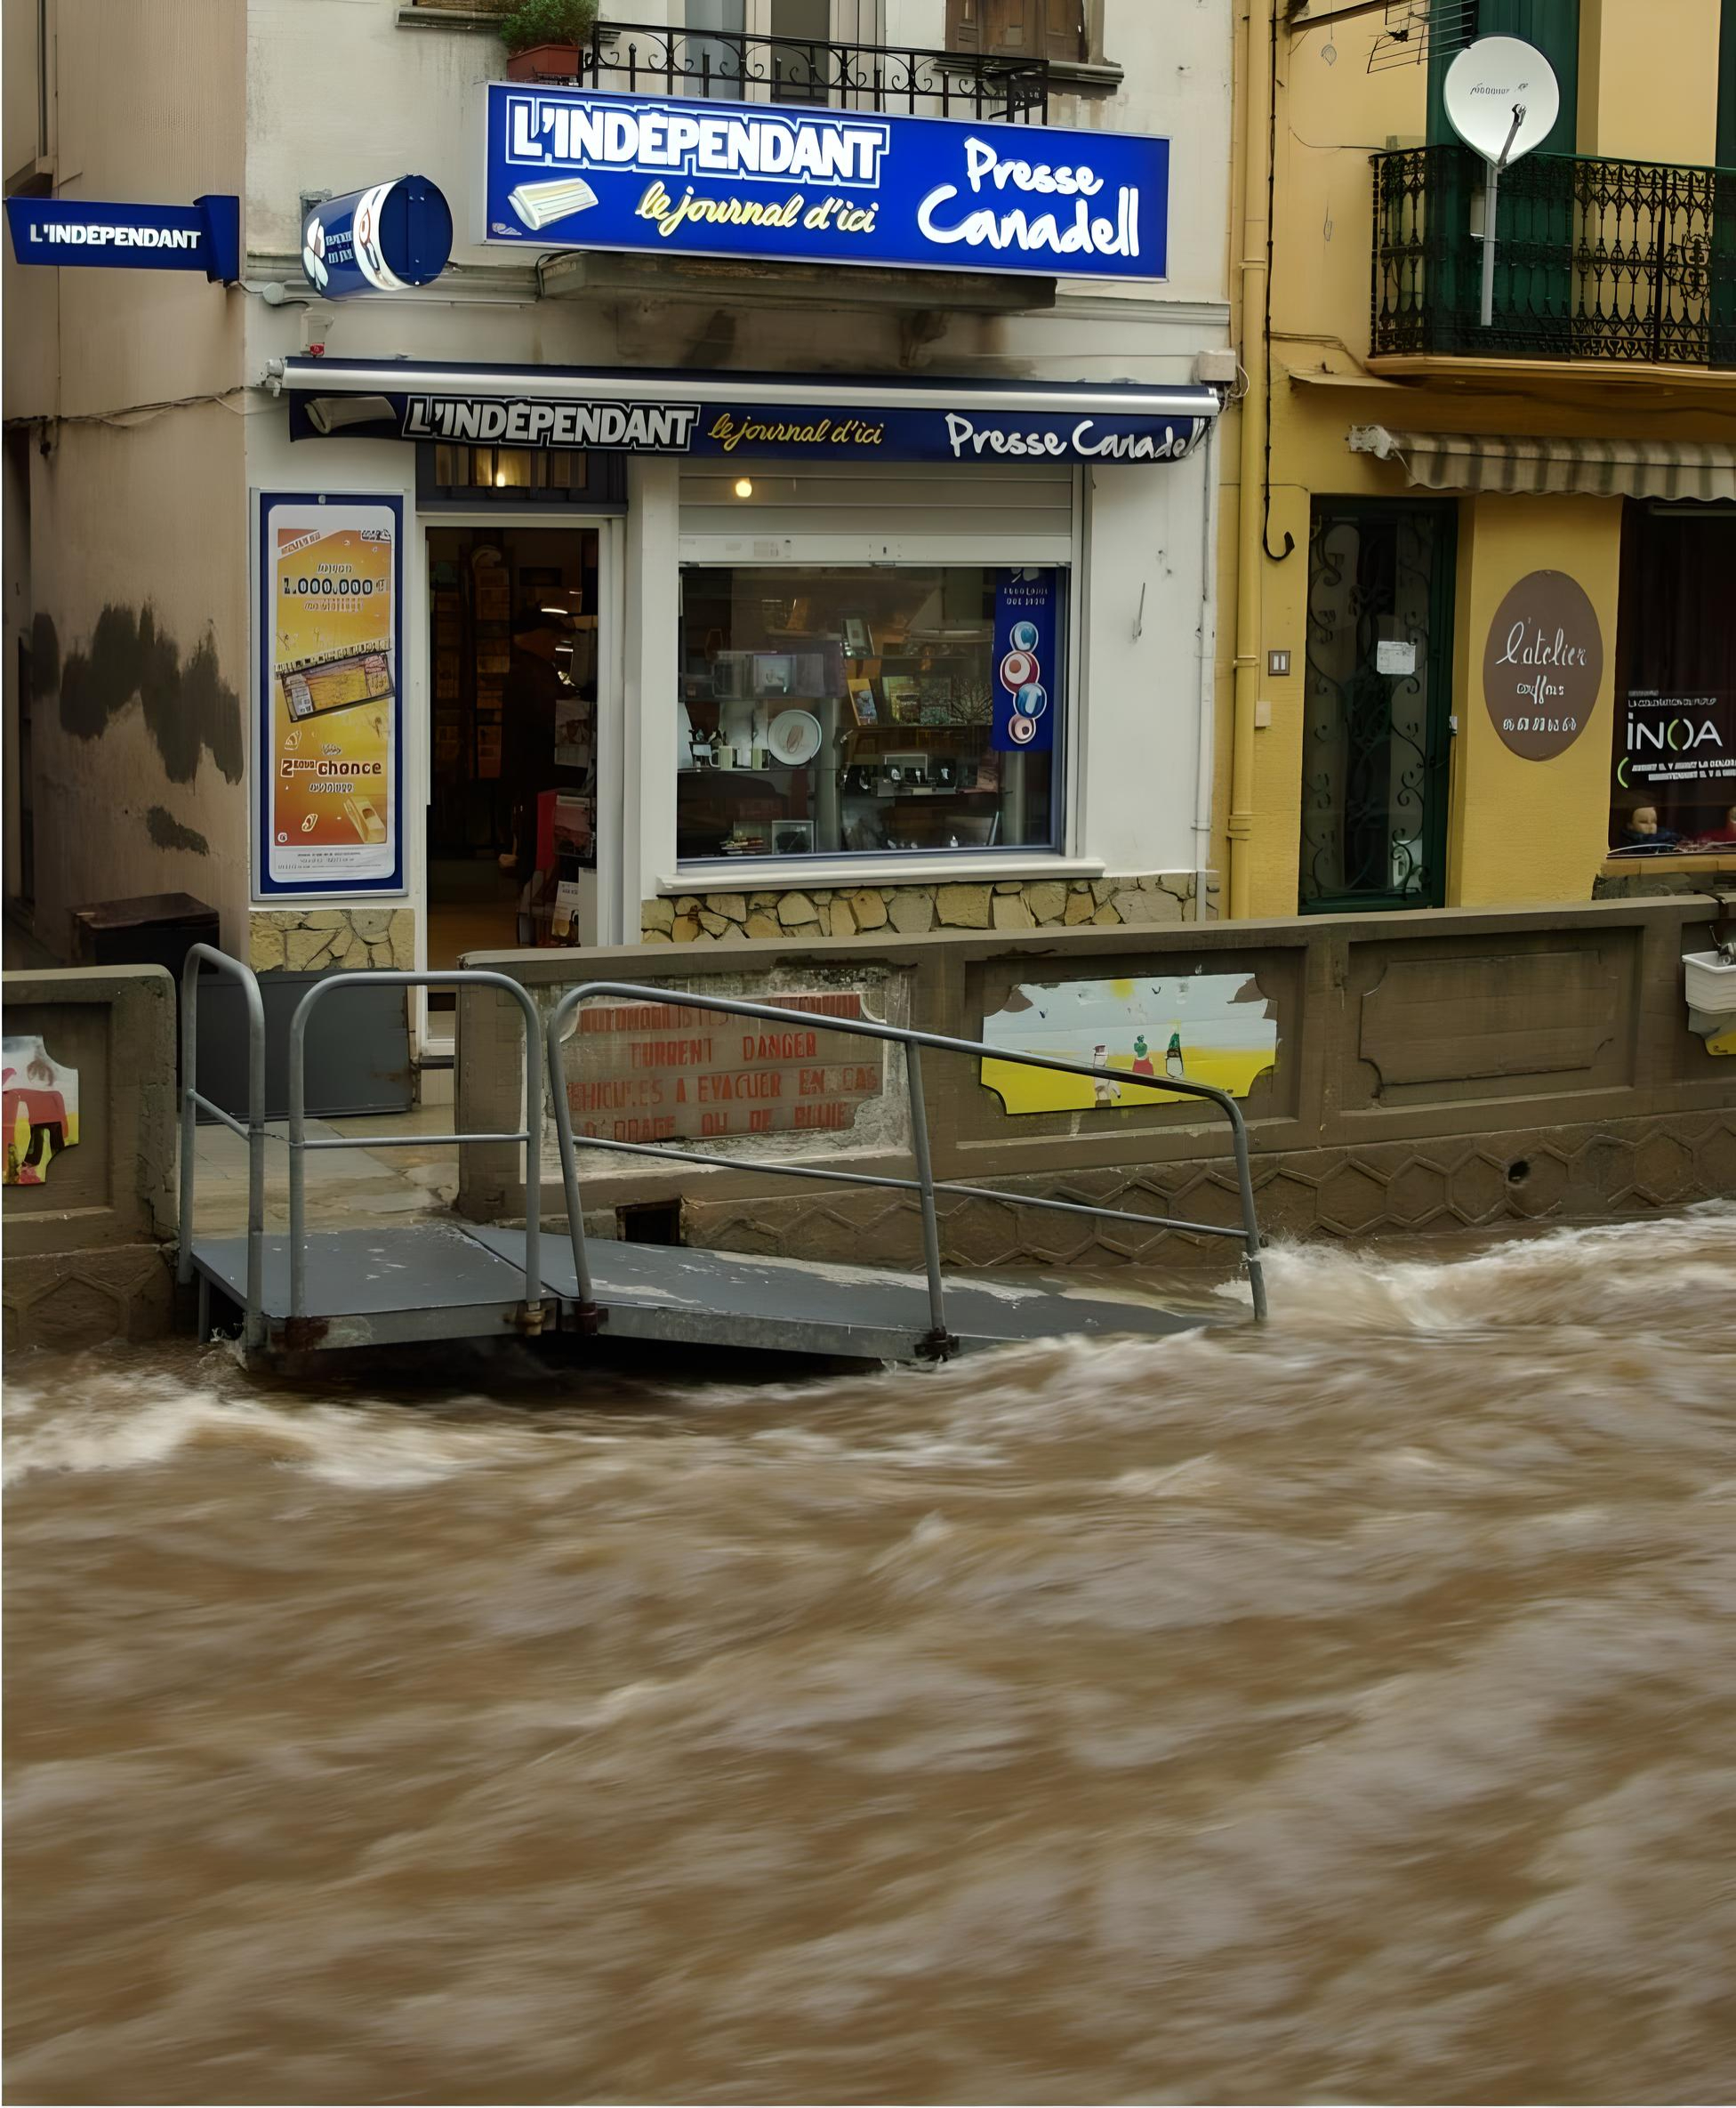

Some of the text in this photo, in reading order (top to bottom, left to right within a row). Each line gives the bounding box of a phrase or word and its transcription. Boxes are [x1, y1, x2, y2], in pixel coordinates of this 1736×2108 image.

[513, 103, 883, 179] L'INDÉPENDANT
[964, 136, 1104, 196] Presse
[658, 186, 805, 237] journal
[804, 197, 880, 234] d'ici
[917, 183, 1139, 257] Canadell
[723, 415, 832, 452] journal
[831, 419, 884, 444] d'ici
[944, 413, 1067, 457] Presse
